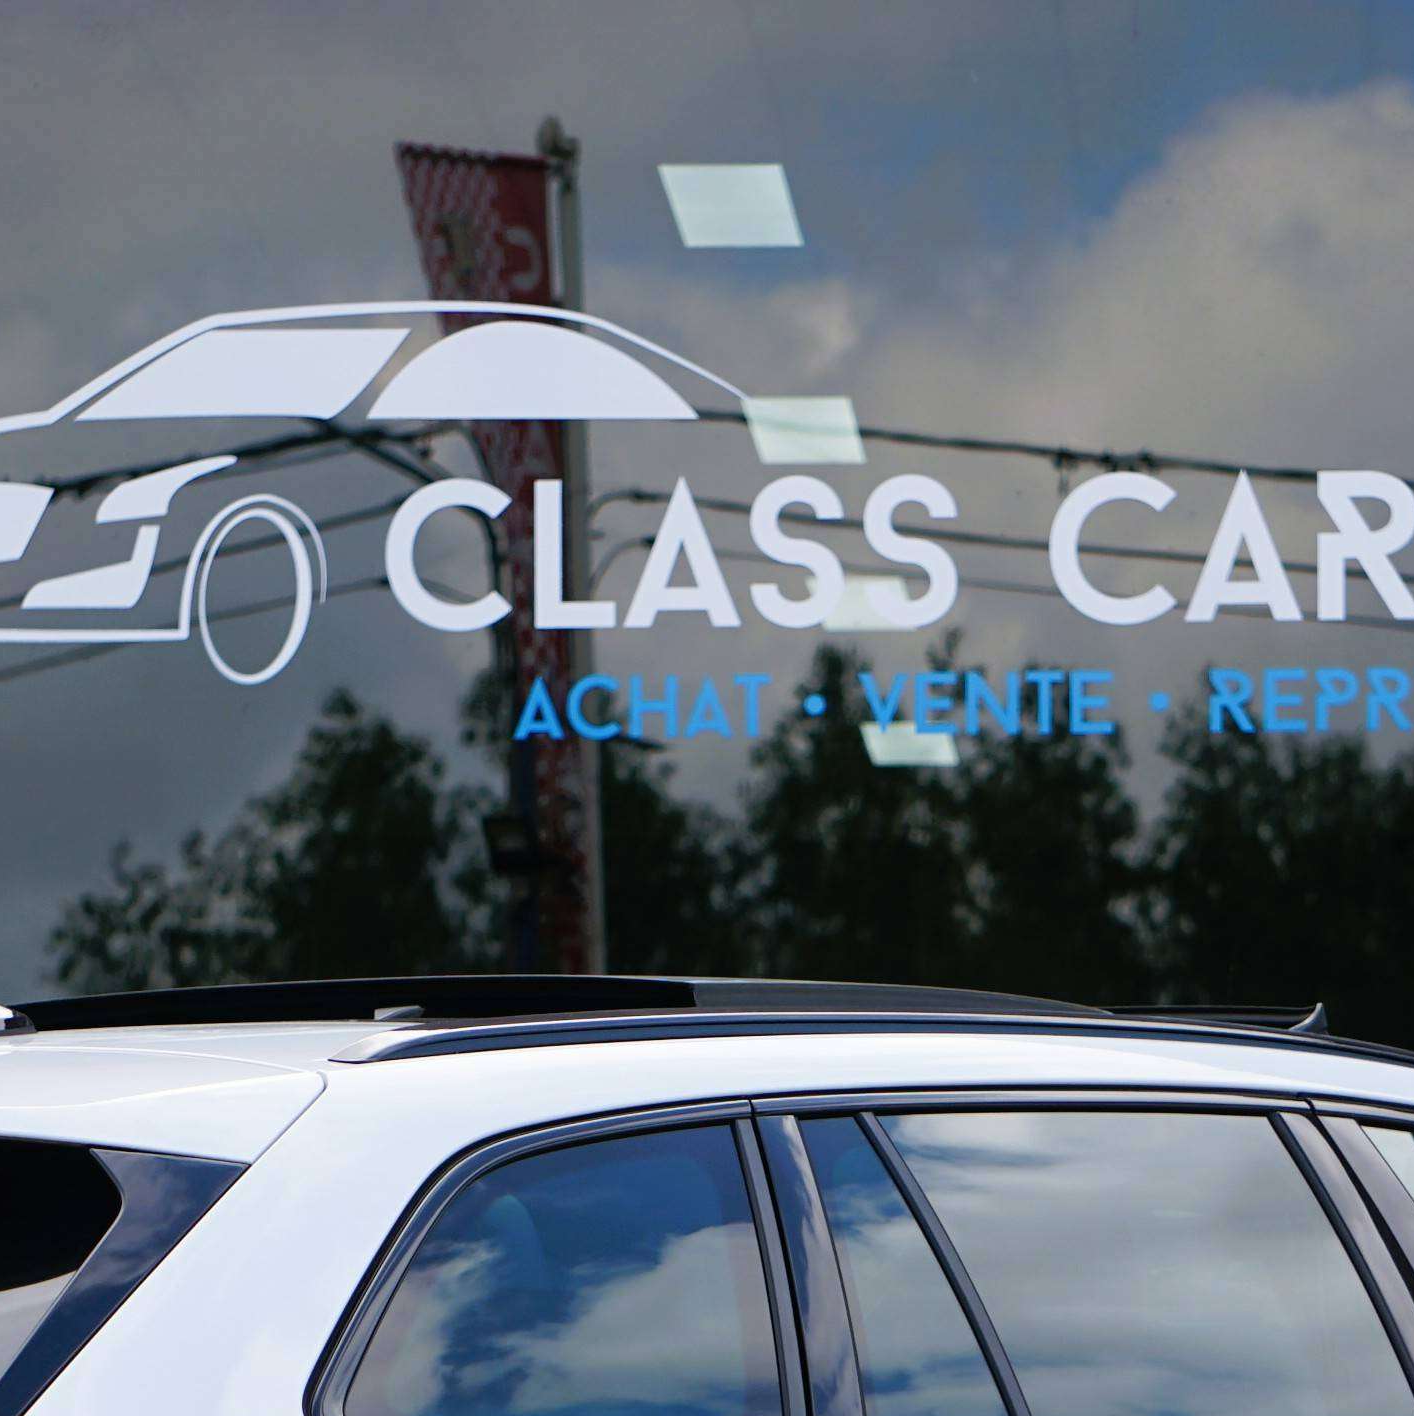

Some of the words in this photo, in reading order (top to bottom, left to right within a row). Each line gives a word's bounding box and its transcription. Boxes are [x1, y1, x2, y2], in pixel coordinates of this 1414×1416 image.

[385, 474, 958, 631] CLASS
[512, 672, 773, 741] ACHAT
[855, 668, 1117, 738] VENTE
